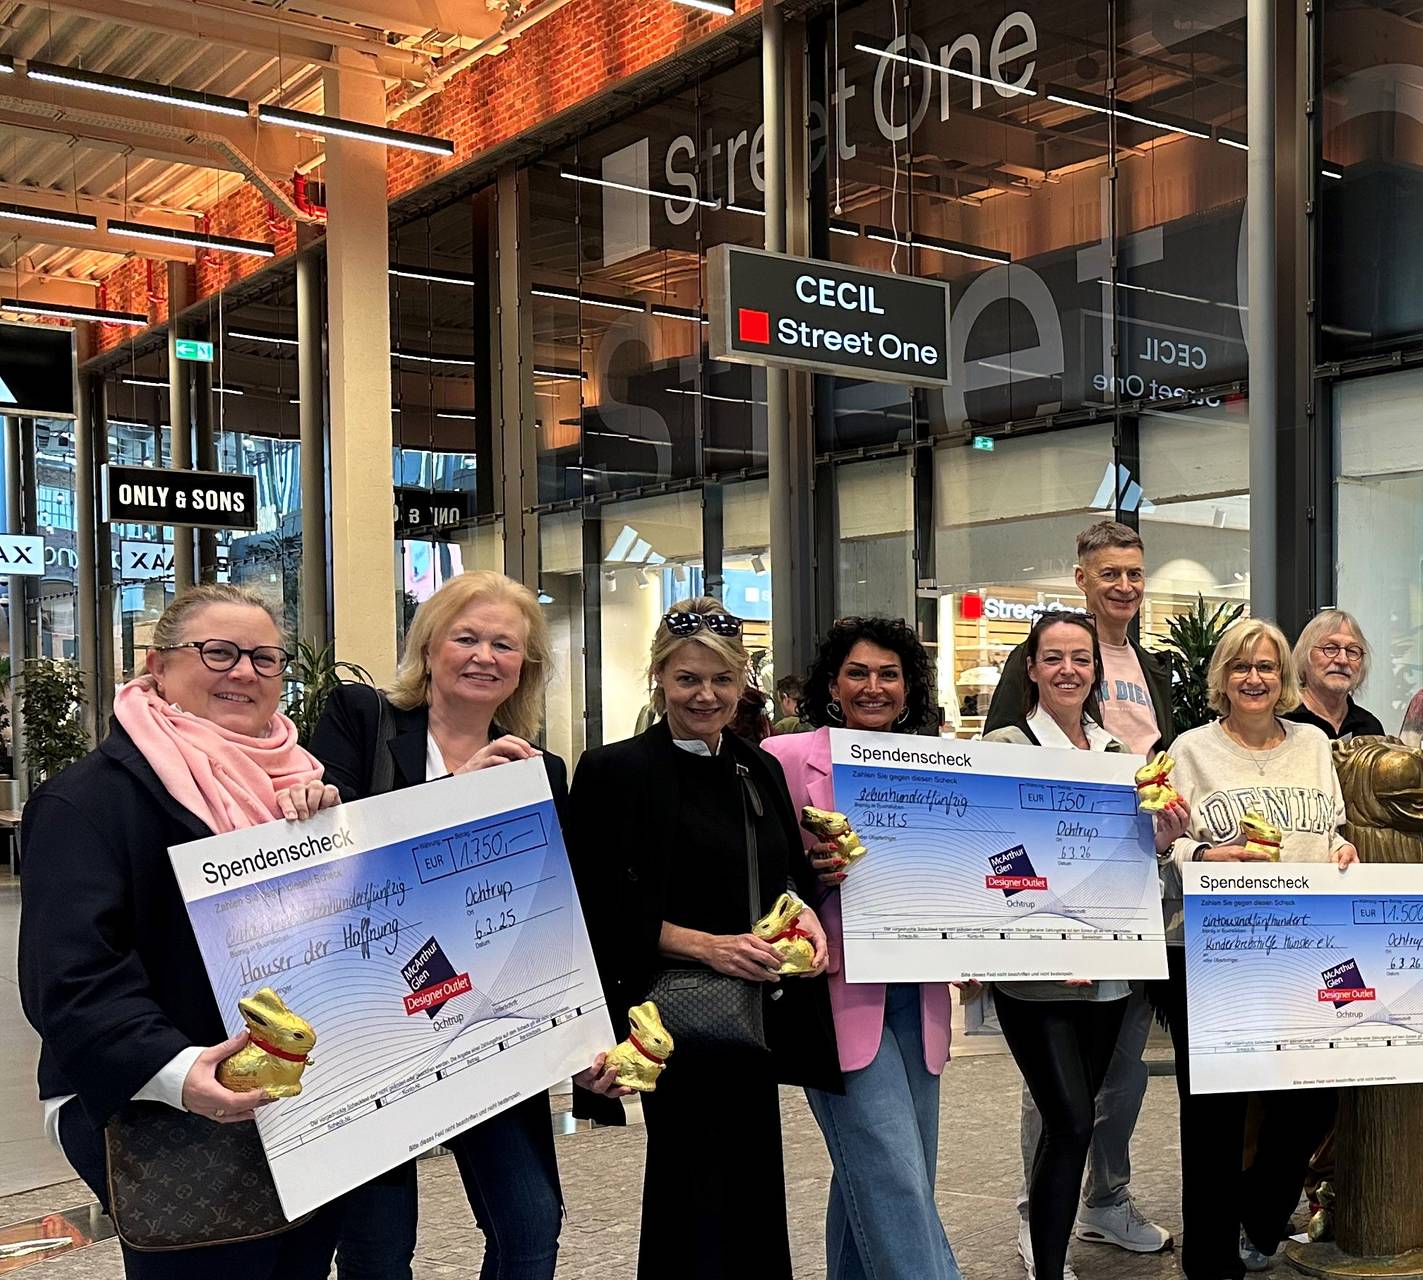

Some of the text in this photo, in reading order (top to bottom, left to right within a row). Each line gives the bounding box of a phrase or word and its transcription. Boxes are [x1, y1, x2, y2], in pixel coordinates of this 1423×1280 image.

[872, 10, 1038, 142] One
[795, 275, 885, 315] CECIL
[778, 318, 938, 365] Street One
[119, 484, 245, 513] ONLY & SONS
[850, 744, 972, 767] Spendenscheck
[1028, 793, 1044, 802] EUR
[863, 810, 909, 828] DKMS
[1057, 820, 1099, 842] Ochtrup
[202, 827, 354, 886] Spendenscheck
[424, 855, 444, 870] EUR
[991, 848, 1024, 867] McArthur
[995, 863, 1013, 876] Glen
[466, 879, 512, 906] Ochtrup
[988, 877, 1045, 888] Designer Outlet
[1200, 875, 1310, 891] Spendenscheck
[1006, 899, 1035, 909] Ochtrup
[1360, 909, 1376, 918] EUR
[475, 908, 516, 940] 6.3.25
[304, 939, 332, 967] der
[343, 917, 399, 960] Hoffnung
[403, 942, 438, 982] McArthur
[1323, 961, 1355, 981] McArthur
[411, 970, 430, 991] Glen
[1327, 976, 1344, 989] Glen
[407, 977, 469, 1010] Designer Outlet
[1320, 989, 1374, 1000] Designer Outlet
[433, 1013, 464, 1032] Ochtrup
[1336, 1011, 1364, 1020] Ochtrup
